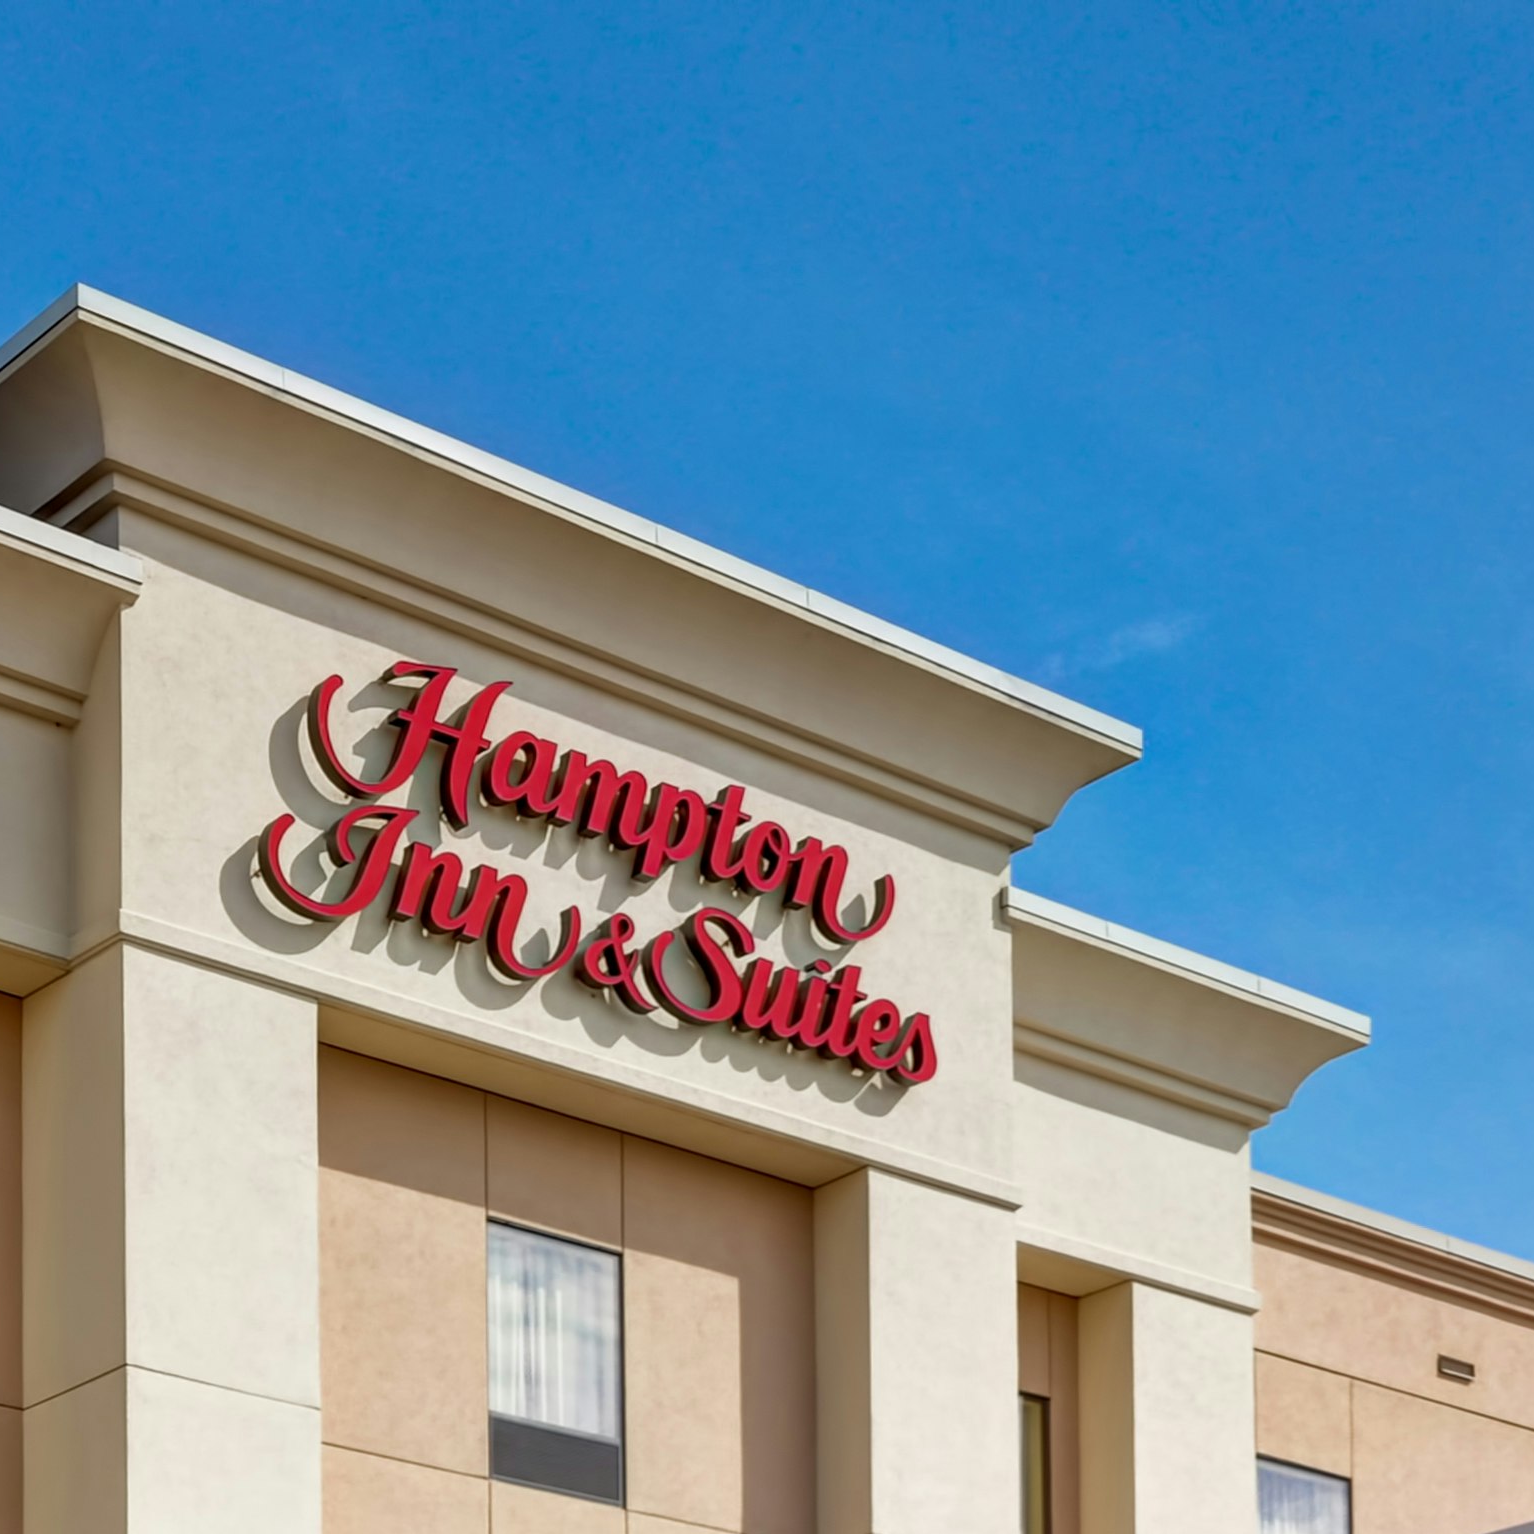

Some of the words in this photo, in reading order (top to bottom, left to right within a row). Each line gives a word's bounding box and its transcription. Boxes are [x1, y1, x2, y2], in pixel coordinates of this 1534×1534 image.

[313, 660, 895, 941] Hampton
[264, 805, 581, 979] Inn
[644, 907, 938, 1085] Suites
